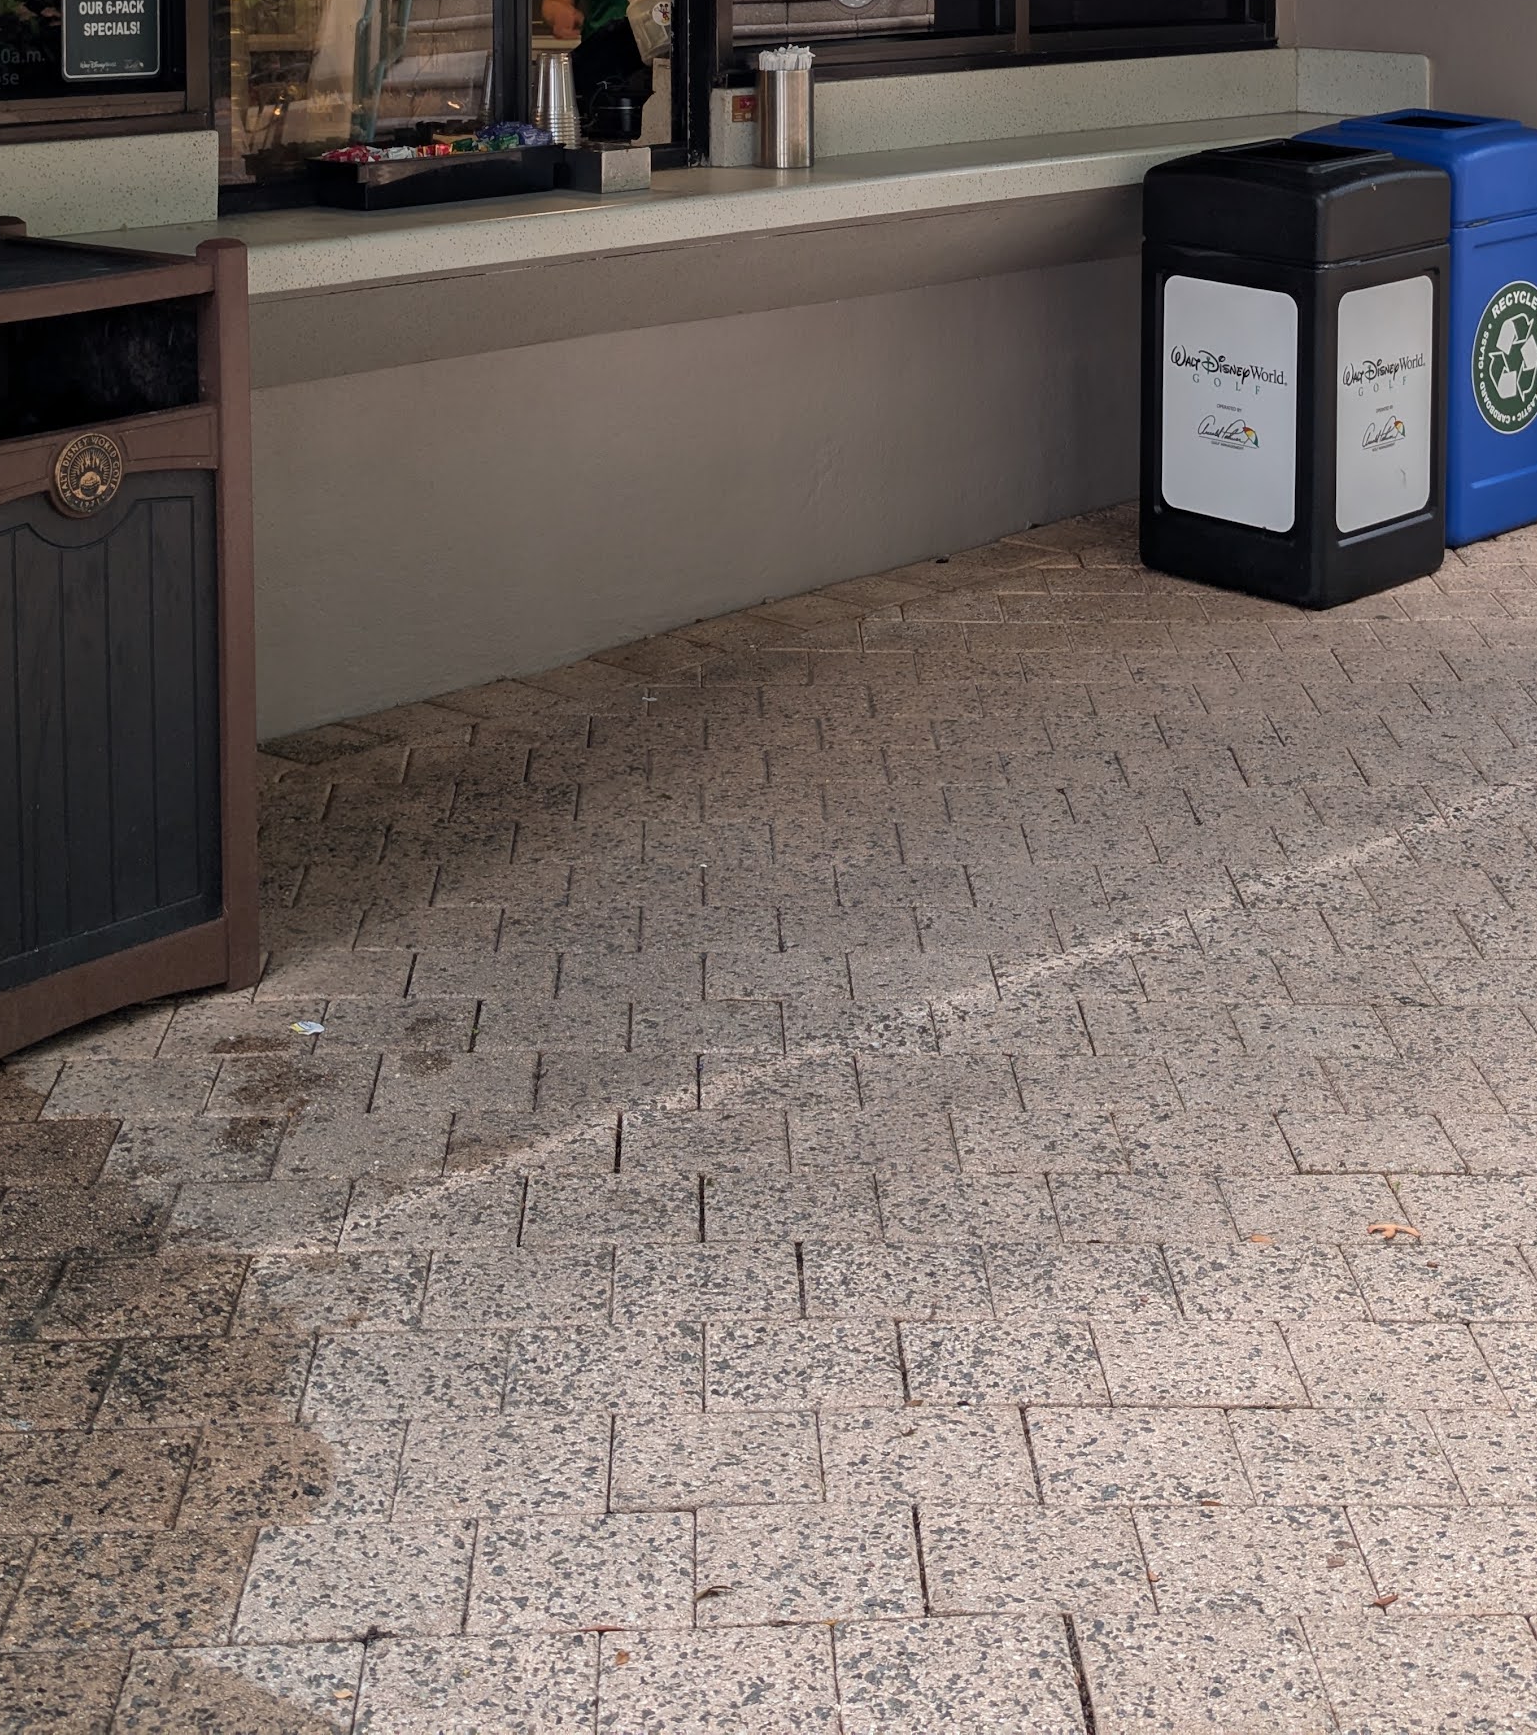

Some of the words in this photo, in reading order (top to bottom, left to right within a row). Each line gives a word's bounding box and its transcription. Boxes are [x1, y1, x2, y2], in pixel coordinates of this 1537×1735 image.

[79, 1, 103, 15] OUR
[106, 0, 144, 13] 6-PACK
[84, 21, 140, 36] SPECIALS!
[1479, 331, 1489, 369] GLASS
[1479, 381, 1510, 424] CARDBOARD
[63, 438, 88, 467] DISNEY
[92, 437, 117, 458] WORLD
[60, 473, 71, 500] WALT
[110, 461, 119, 489] GOLF
